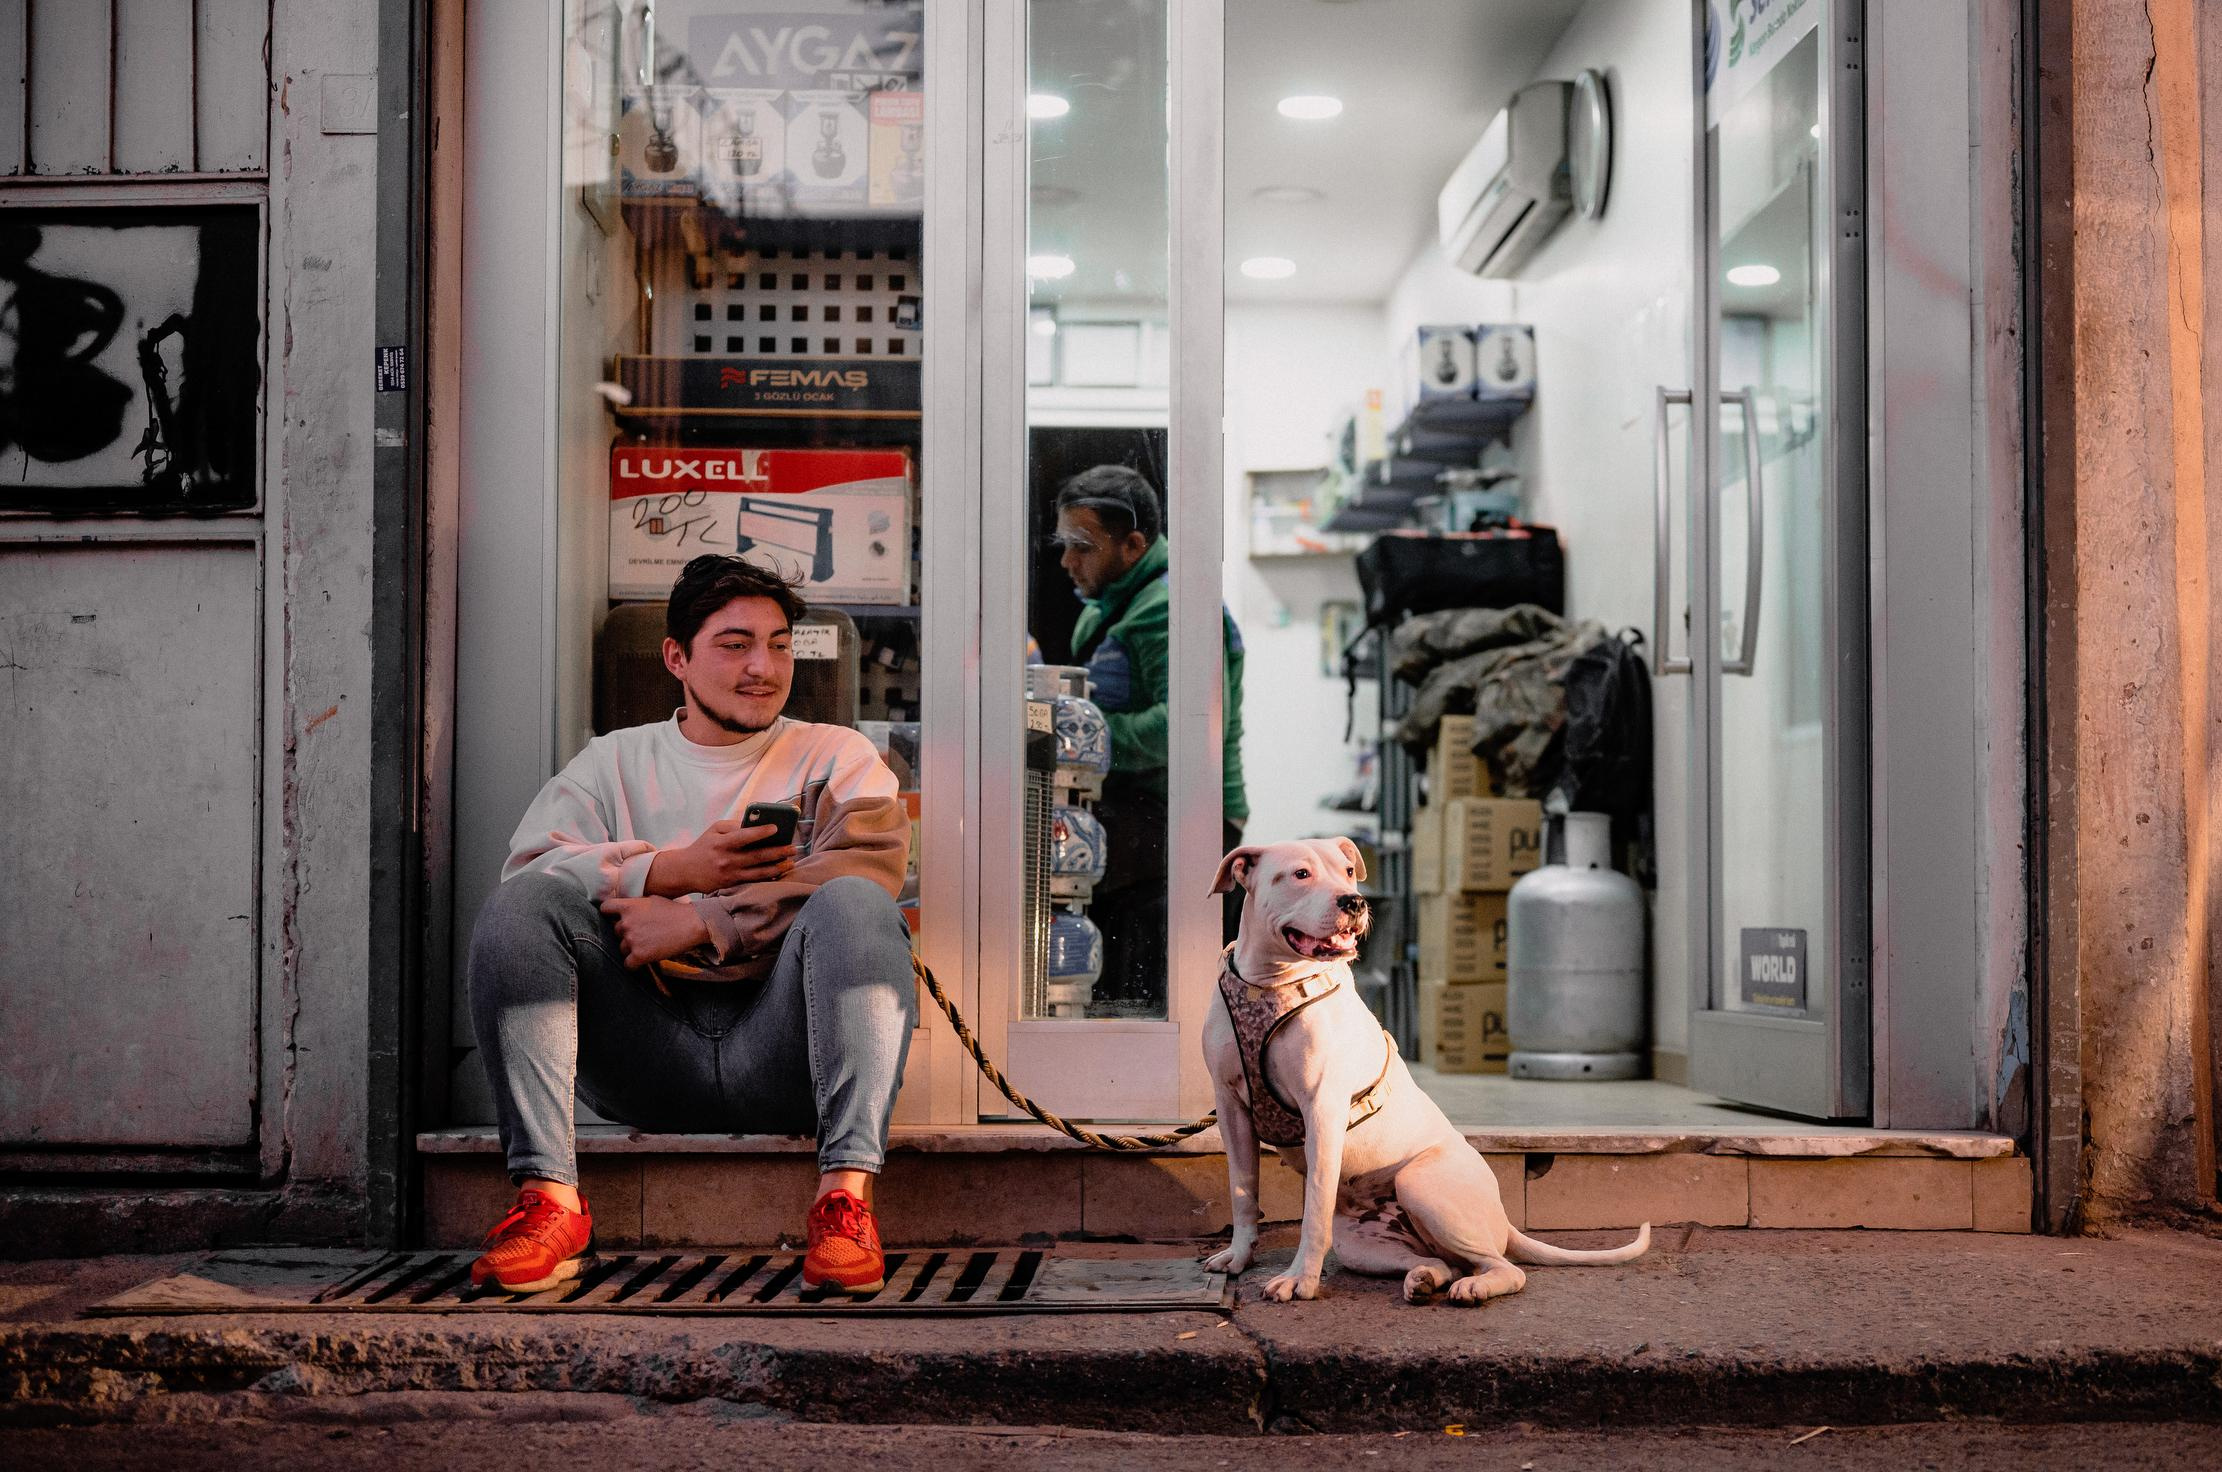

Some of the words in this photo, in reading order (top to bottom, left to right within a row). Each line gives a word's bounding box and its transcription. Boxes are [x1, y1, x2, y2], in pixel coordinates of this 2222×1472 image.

[750, 369, 869, 391] FEMAŞ
[802, 392, 834, 402] OCAK
[1751, 955, 1796, 983] WORLD
